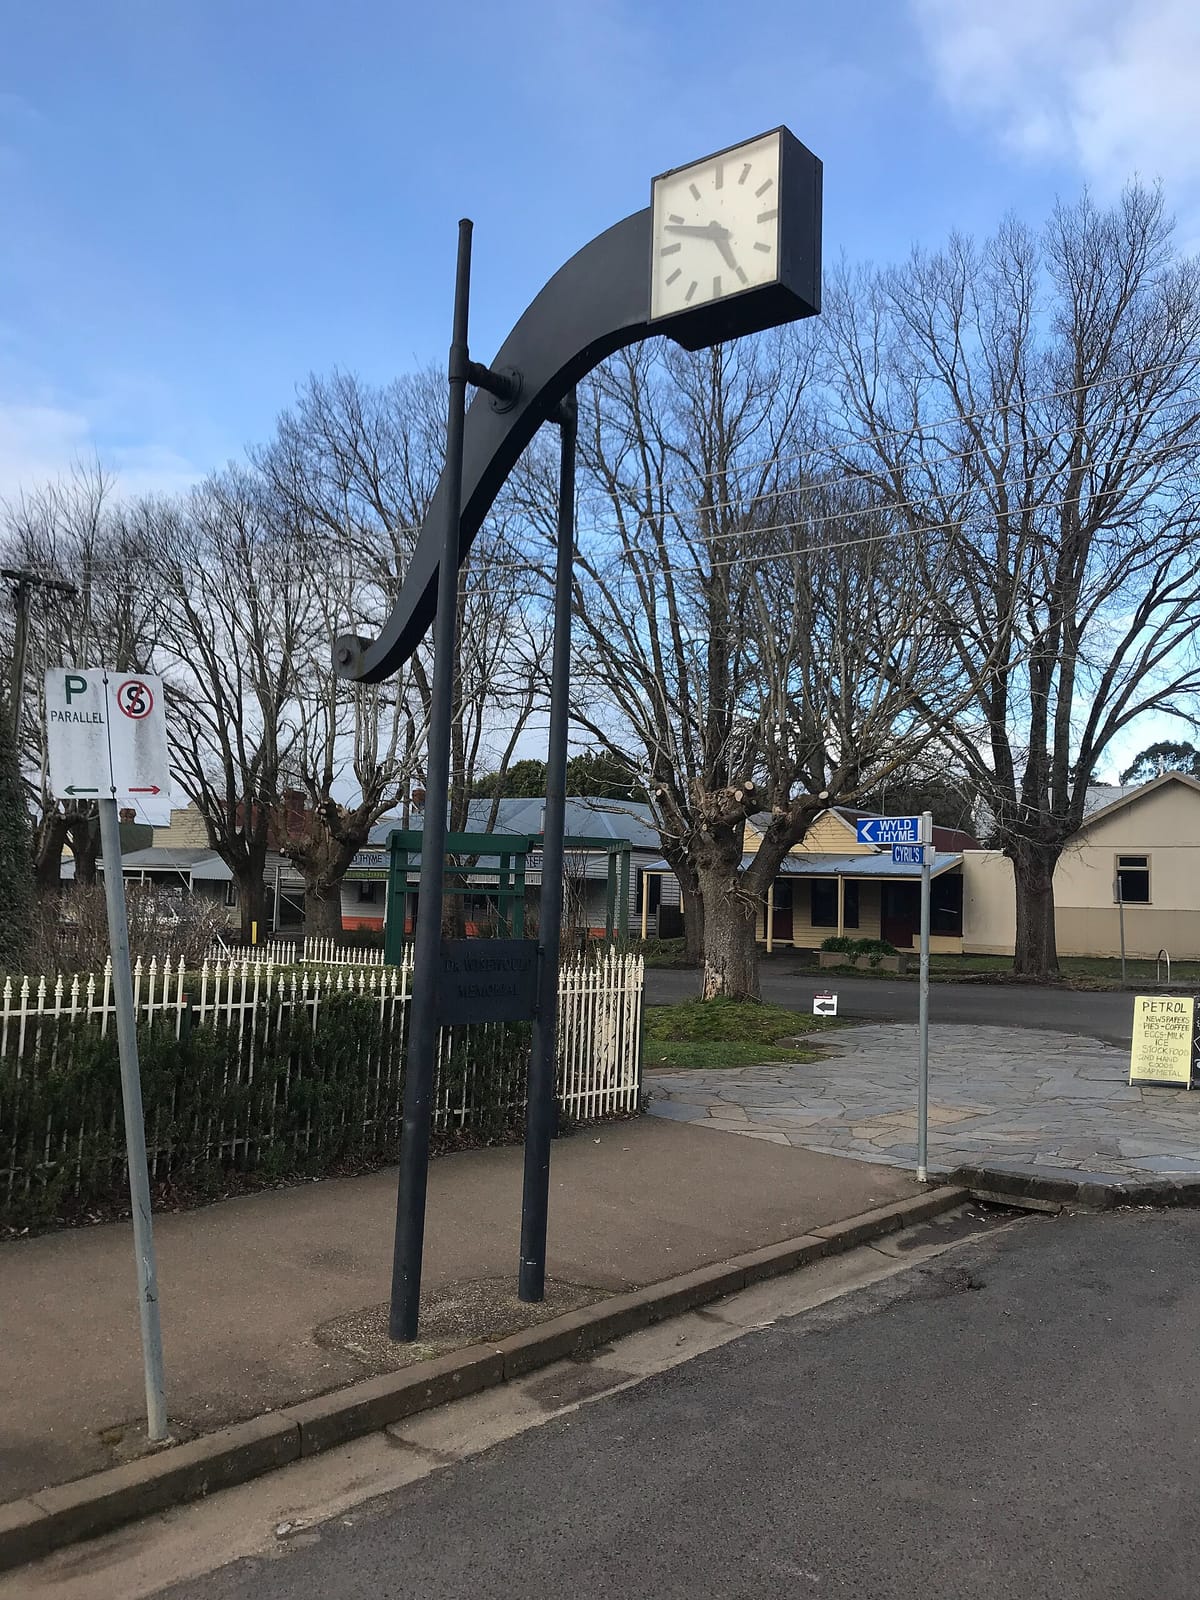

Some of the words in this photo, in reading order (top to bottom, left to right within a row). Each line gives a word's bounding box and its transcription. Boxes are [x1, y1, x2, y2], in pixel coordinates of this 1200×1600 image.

[64, 674, 88, 705] P
[50, 709, 105, 724] PARALLEL
[879, 819, 912, 831] WYLD
[876, 830, 915, 842] THYME
[894, 846, 920, 863] CYRIL'S
[1142, 1001, 1187, 1013] PETROL
[1145, 1015, 1190, 1024] NEWSPAPERS
[1154, 1039, 1169, 1047] ICE
[1155, 1055, 1179, 1064] HAND
[1155, 1068, 1183, 1078] METAL
